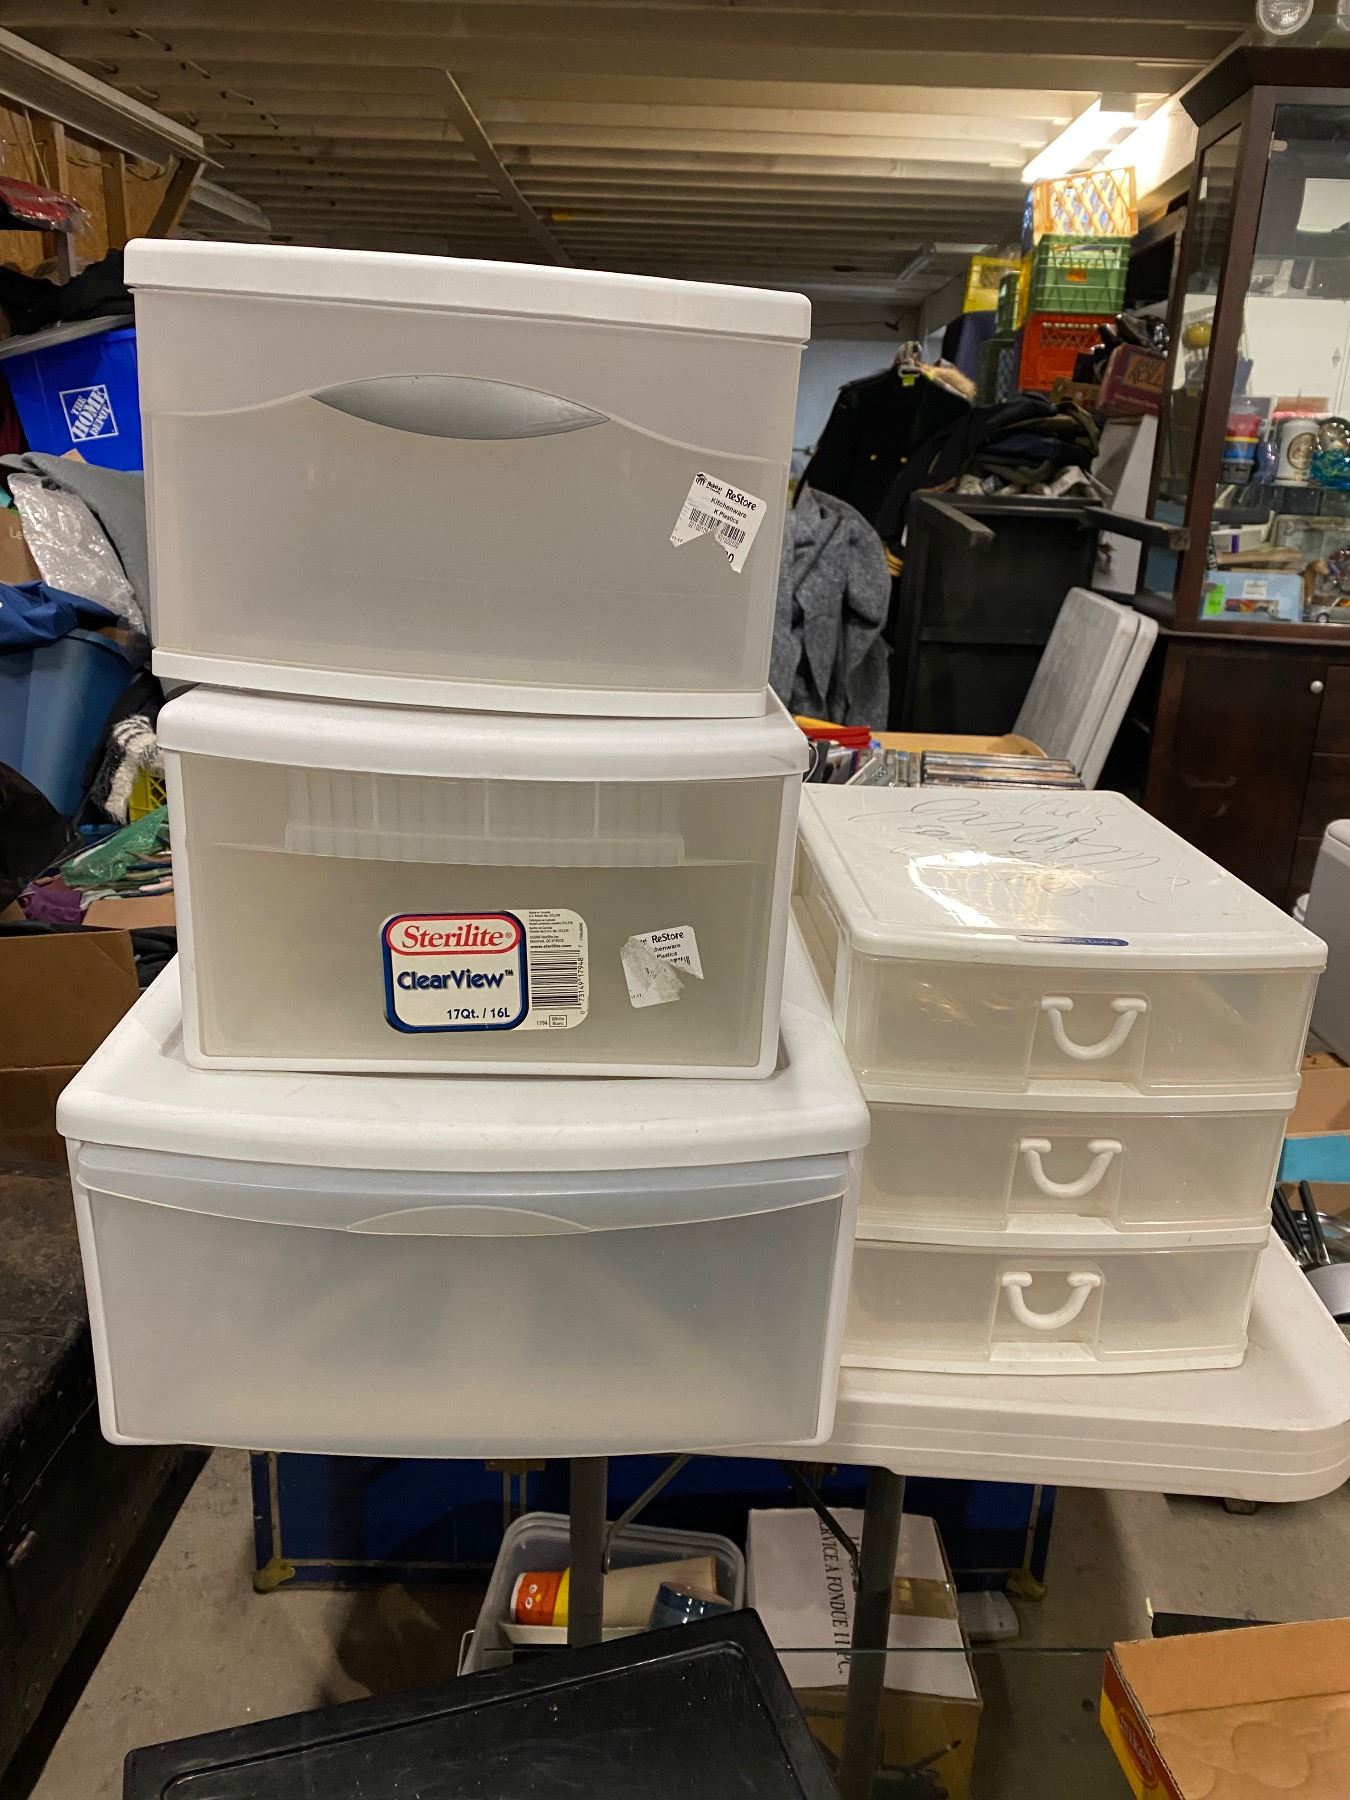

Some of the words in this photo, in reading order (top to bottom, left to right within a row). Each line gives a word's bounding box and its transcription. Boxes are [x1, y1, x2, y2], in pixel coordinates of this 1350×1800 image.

[71, 395, 87, 415] THE
[72, 388, 106, 438] HOME
[89, 404, 110, 437] DEPOT
[710, 497, 747, 519] Kitchenware
[725, 488, 757, 511] ReStore
[719, 511, 739, 525] Plastics
[402, 924, 503, 948] Sterilite
[651, 931, 685, 944] ReStore
[397, 969, 504, 990] ClearView
[446, 1008, 480, 1020] 17Qt.
[490, 1008, 511, 1018] 16L
[819, 1518, 840, 1563] ERVICE
[826, 1575, 849, 1628] FONDUE
